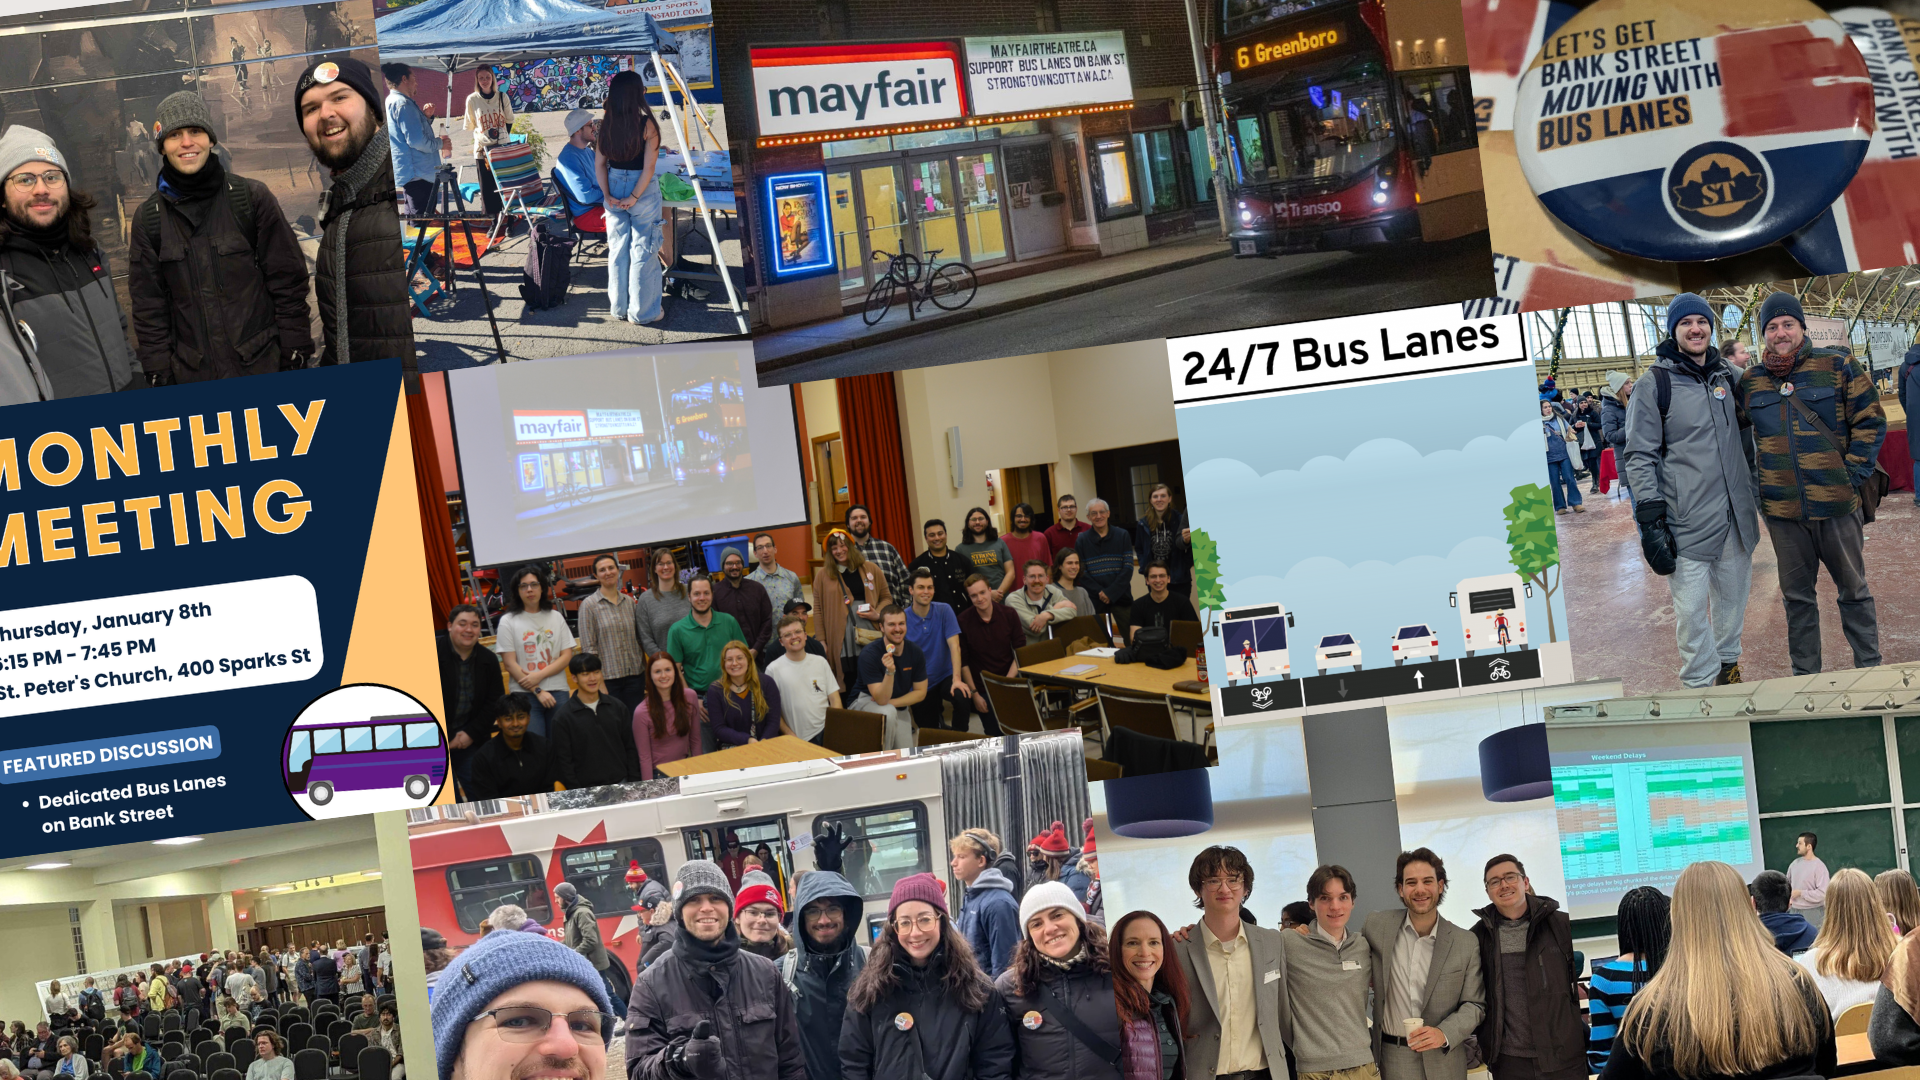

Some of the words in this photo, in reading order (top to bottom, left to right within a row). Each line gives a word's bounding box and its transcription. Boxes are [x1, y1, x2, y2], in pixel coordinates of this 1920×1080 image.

[651, 8, 703, 19] NSTADT.COM
[666, 1, 698, 10] SPORTS
[990, 40, 1097, 58] MAYFAIRTHEATRE.CA
[1237, 47, 1250, 69] 6
[1256, 30, 1338, 63] Greenboro
[1543, 28, 1606, 60] LET'S
[1615, 20, 1656, 46] GET
[1872, 18, 1912, 64] BANK
[969, 60, 1014, 74] SUPPORT
[1018, 58, 1038, 72] BUS
[1040, 56, 1072, 70] LANES
[1074, 56, 1086, 68] ON
[1088, 54, 1112, 66] BANK
[1114, 53, 1125, 65] ST
[1409, 50, 1433, 66] 8108
[1541, 53, 1605, 87] BANK
[1614, 38, 1701, 73] STREET
[768, 67, 947, 120] mayfair
[986, 69, 1114, 90] STRONGTOWNSOTTAWA.CA
[1540, 72, 1648, 117] MOVING
[1653, 62, 1722, 95] WITH
[1843, 22, 1897, 98] MVING
[1876, 102, 1918, 159] WITH
[1539, 112, 1592, 151] BUS
[1603, 96, 1690, 137] LANES
[1701, 180, 1736, 205] ST
[1182, 341, 1280, 386] 24/7
[1292, 338, 1369, 372] Bus
[1380, 322, 1500, 361] Lanes
[520, 419, 582, 436] mayfair
[676, 416, 680, 424] 6
[682, 412, 708, 423] Greenboro
[971, 552, 996, 560] STRONG
[0, 619, 88, 642] hursday,
[92, 607, 174, 630] January
[178, 602, 212, 620] 8th
[0, 654, 28, 671] :15
[32, 649, 62, 667] PM
[80, 642, 122, 662] 7:45
[126, 638, 156, 655] PM
[24, 675, 90, 698] Peter's
[94, 666, 173, 688] Church,
[177, 659, 215, 678] 400
[219, 650, 287, 676] Sparks
[291, 648, 312, 664] St
[2, 750, 96, 774] FEATURED
[100, 735, 213, 762] DISCUSSION
[1623, 752, 1646, 760] Delays
[38, 784, 132, 809] Dedicated
[136, 782, 170, 798] Bus
[173, 776, 226, 793] Lanes
[42, 819, 66, 834] on
[68, 812, 116, 830] Bank
[119, 804, 174, 824] Street
